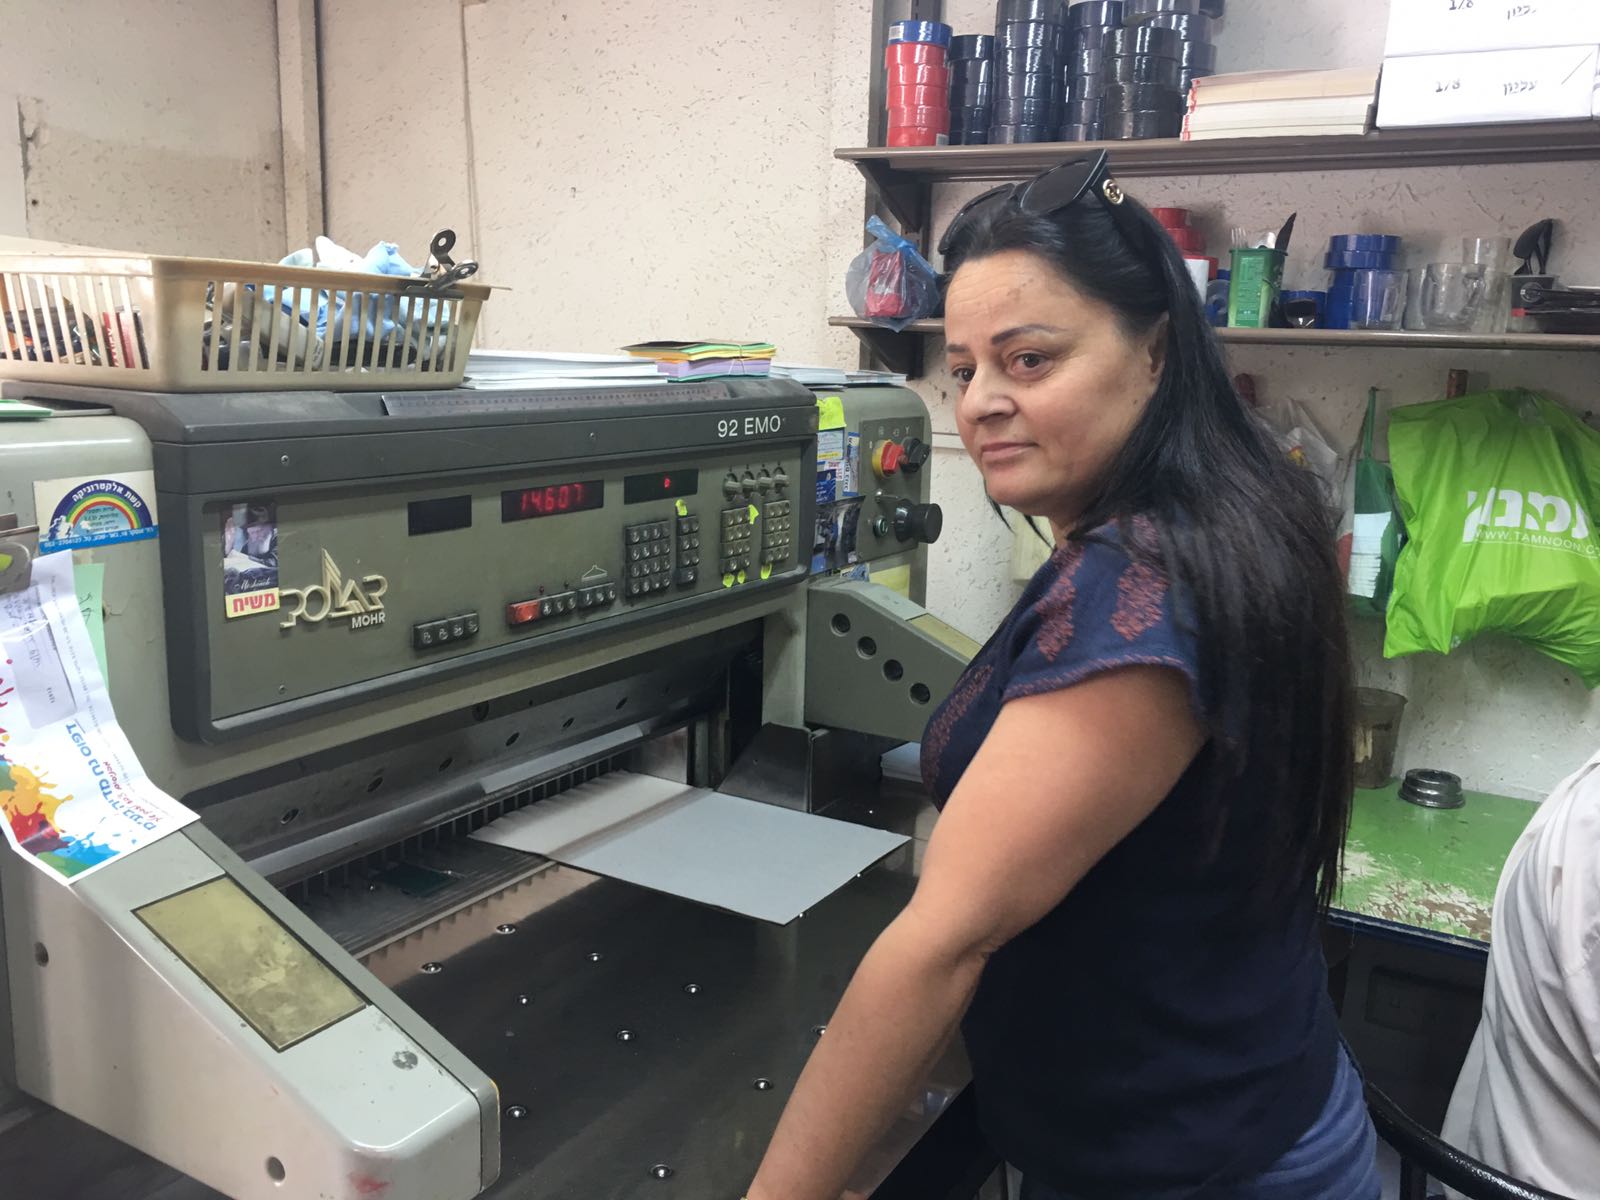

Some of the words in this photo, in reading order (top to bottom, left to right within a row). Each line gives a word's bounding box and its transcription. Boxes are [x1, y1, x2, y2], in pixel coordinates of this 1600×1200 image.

[717, 420, 738, 438] 92
[744, 415, 781, 436] EMO
[72, 482, 123, 502] אלקטרוניקה
[125, 490, 142, 508] קשת
[233, 593, 276, 613] משיח
[351, 612, 386, 630] MOHR
[65, 722, 92, 757] דפוס
[88, 758, 104, 776] נח
[98, 779, 125, 811] מדיה
